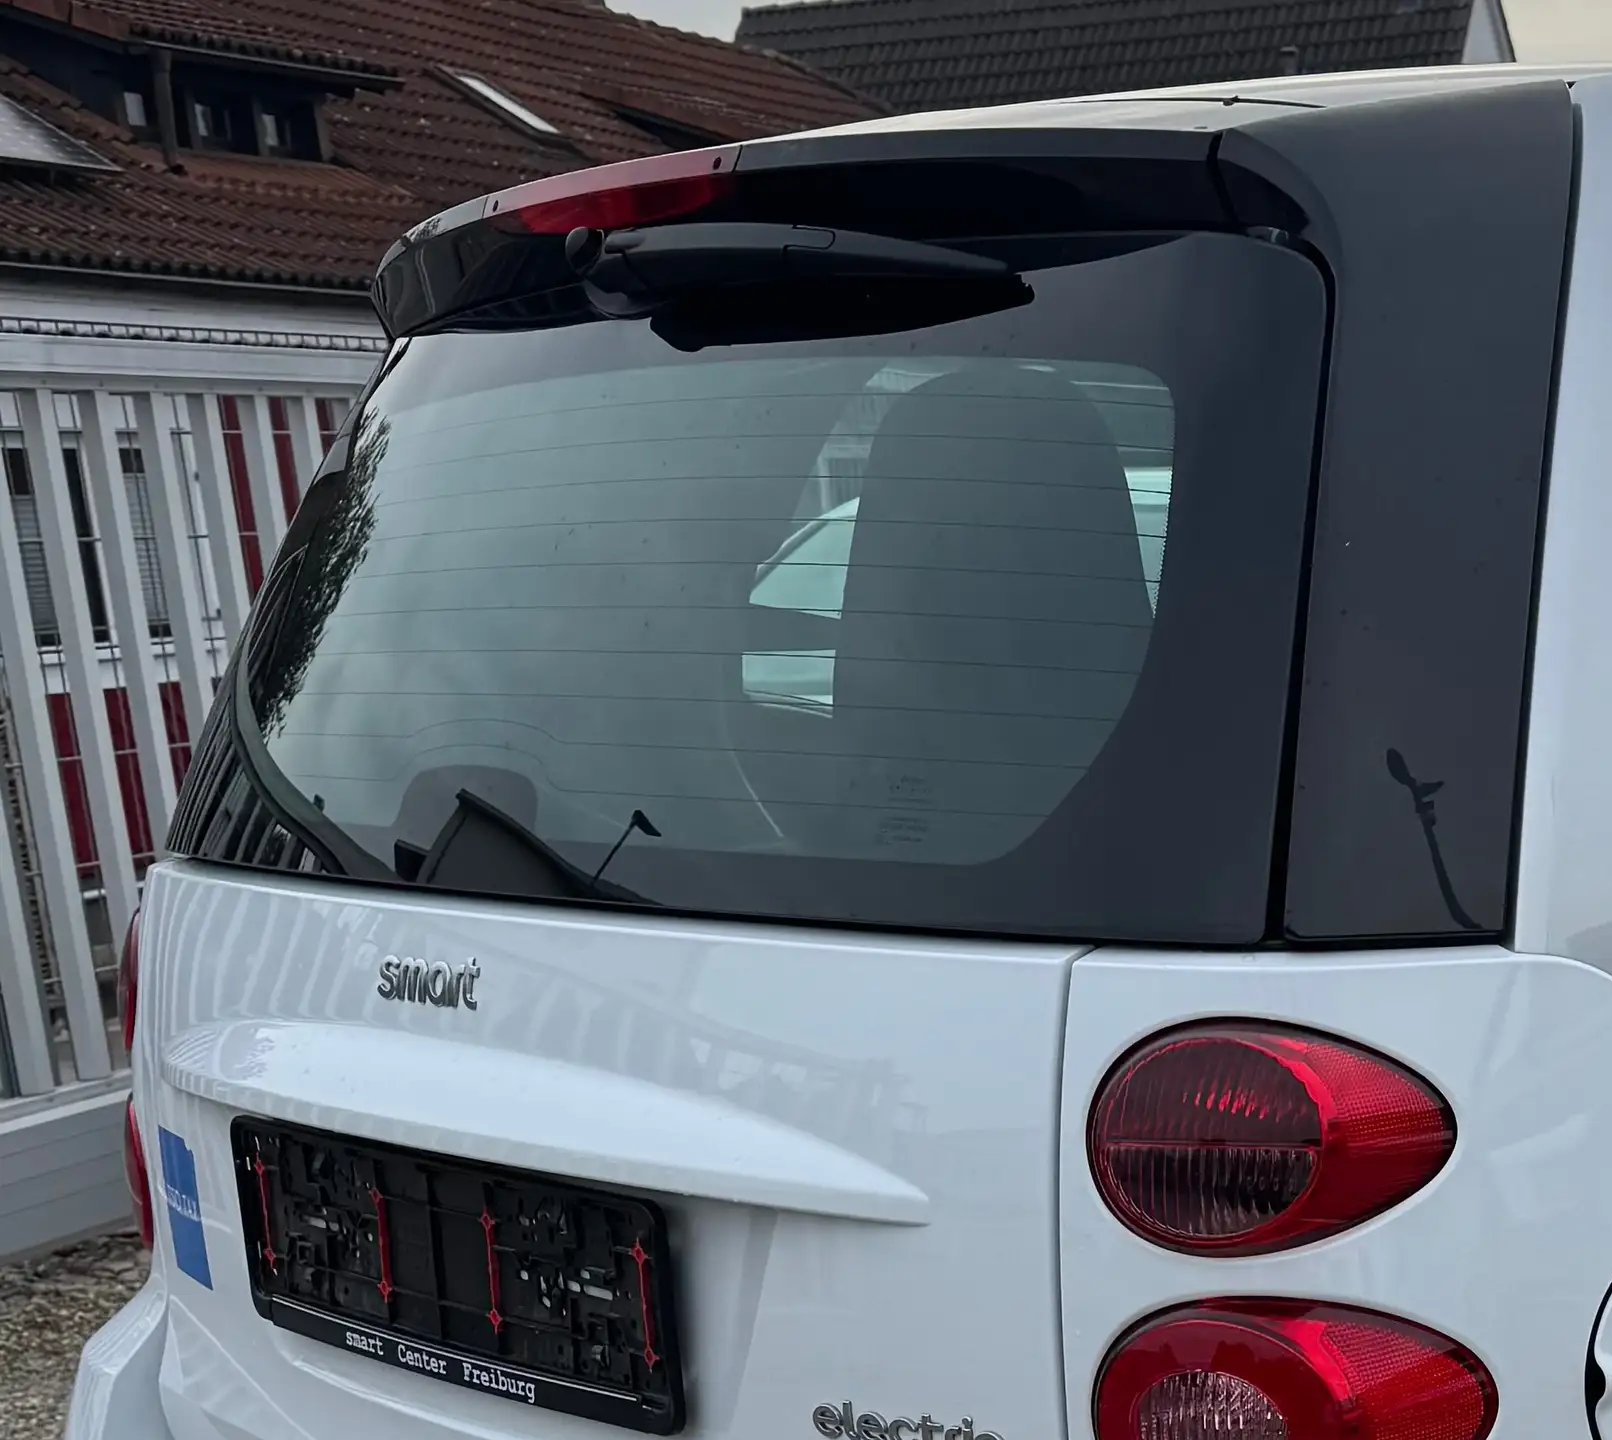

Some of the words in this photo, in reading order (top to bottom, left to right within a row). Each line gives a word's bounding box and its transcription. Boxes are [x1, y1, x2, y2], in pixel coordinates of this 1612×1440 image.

[377, 954, 480, 1011] smart
[346, 1331, 384, 1356] smart
[397, 1345, 447, 1375] Center
[462, 1362, 536, 1404] Freiburg
